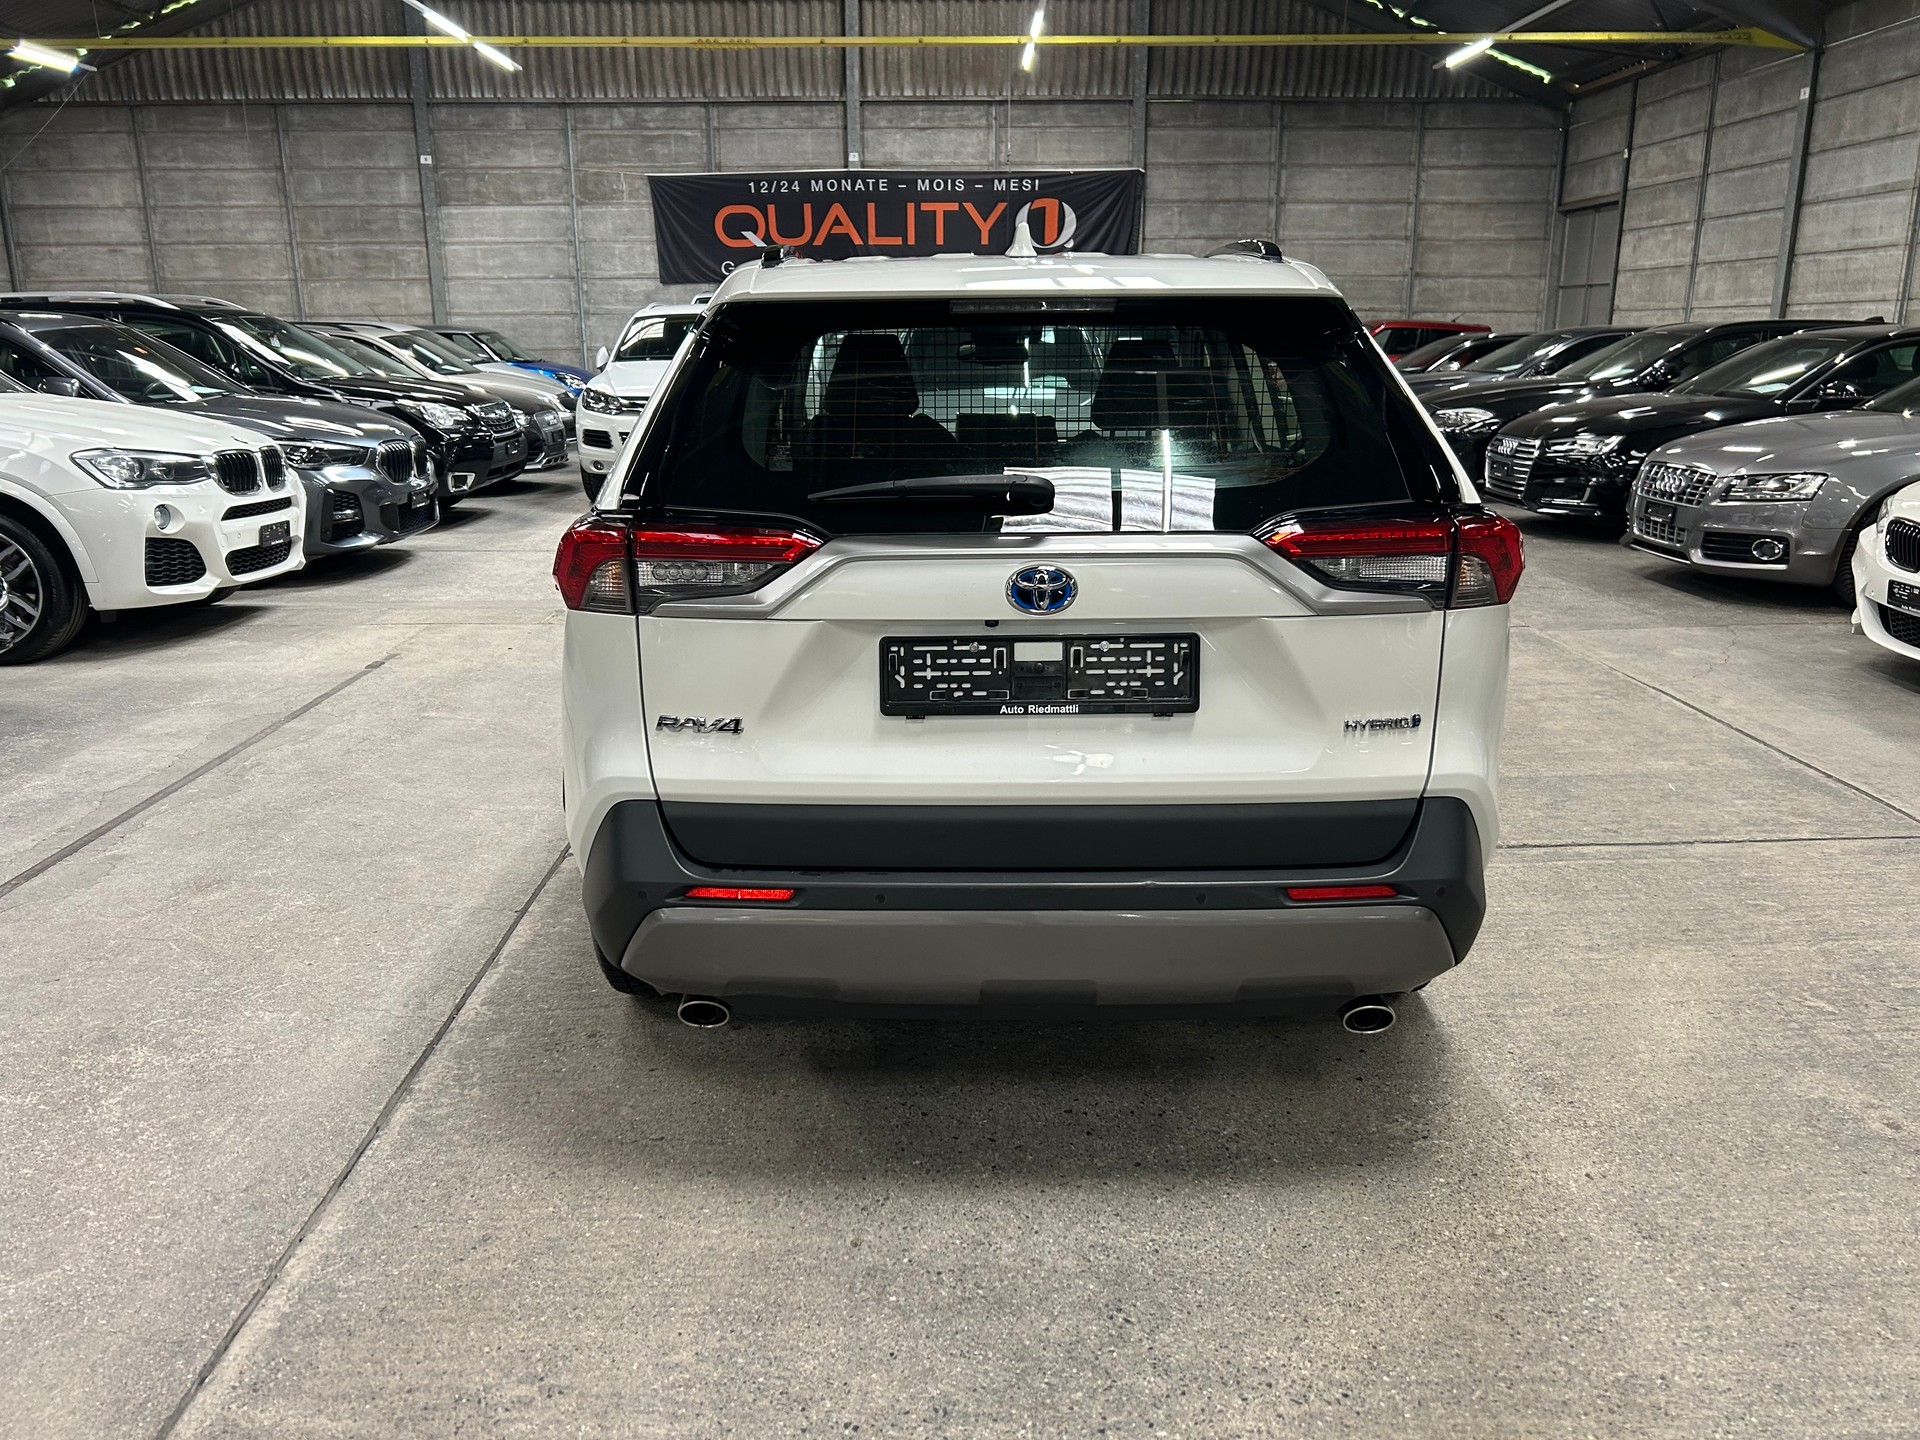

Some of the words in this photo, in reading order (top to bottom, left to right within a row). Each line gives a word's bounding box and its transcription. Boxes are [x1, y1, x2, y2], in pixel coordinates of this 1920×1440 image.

[748, 180, 800, 193] 12/24
[810, 179, 889, 192] MONATE
[917, 179, 965, 191] MOIS
[993, 179, 1040, 191] MESI
[714, 202, 1008, 248] QUALITY
[1000, 705, 1025, 714] Auto
[1028, 704, 1079, 714] Riedmattli
[656, 715, 744, 735] RAV4
[1343, 718, 1410, 732] HYBRID
